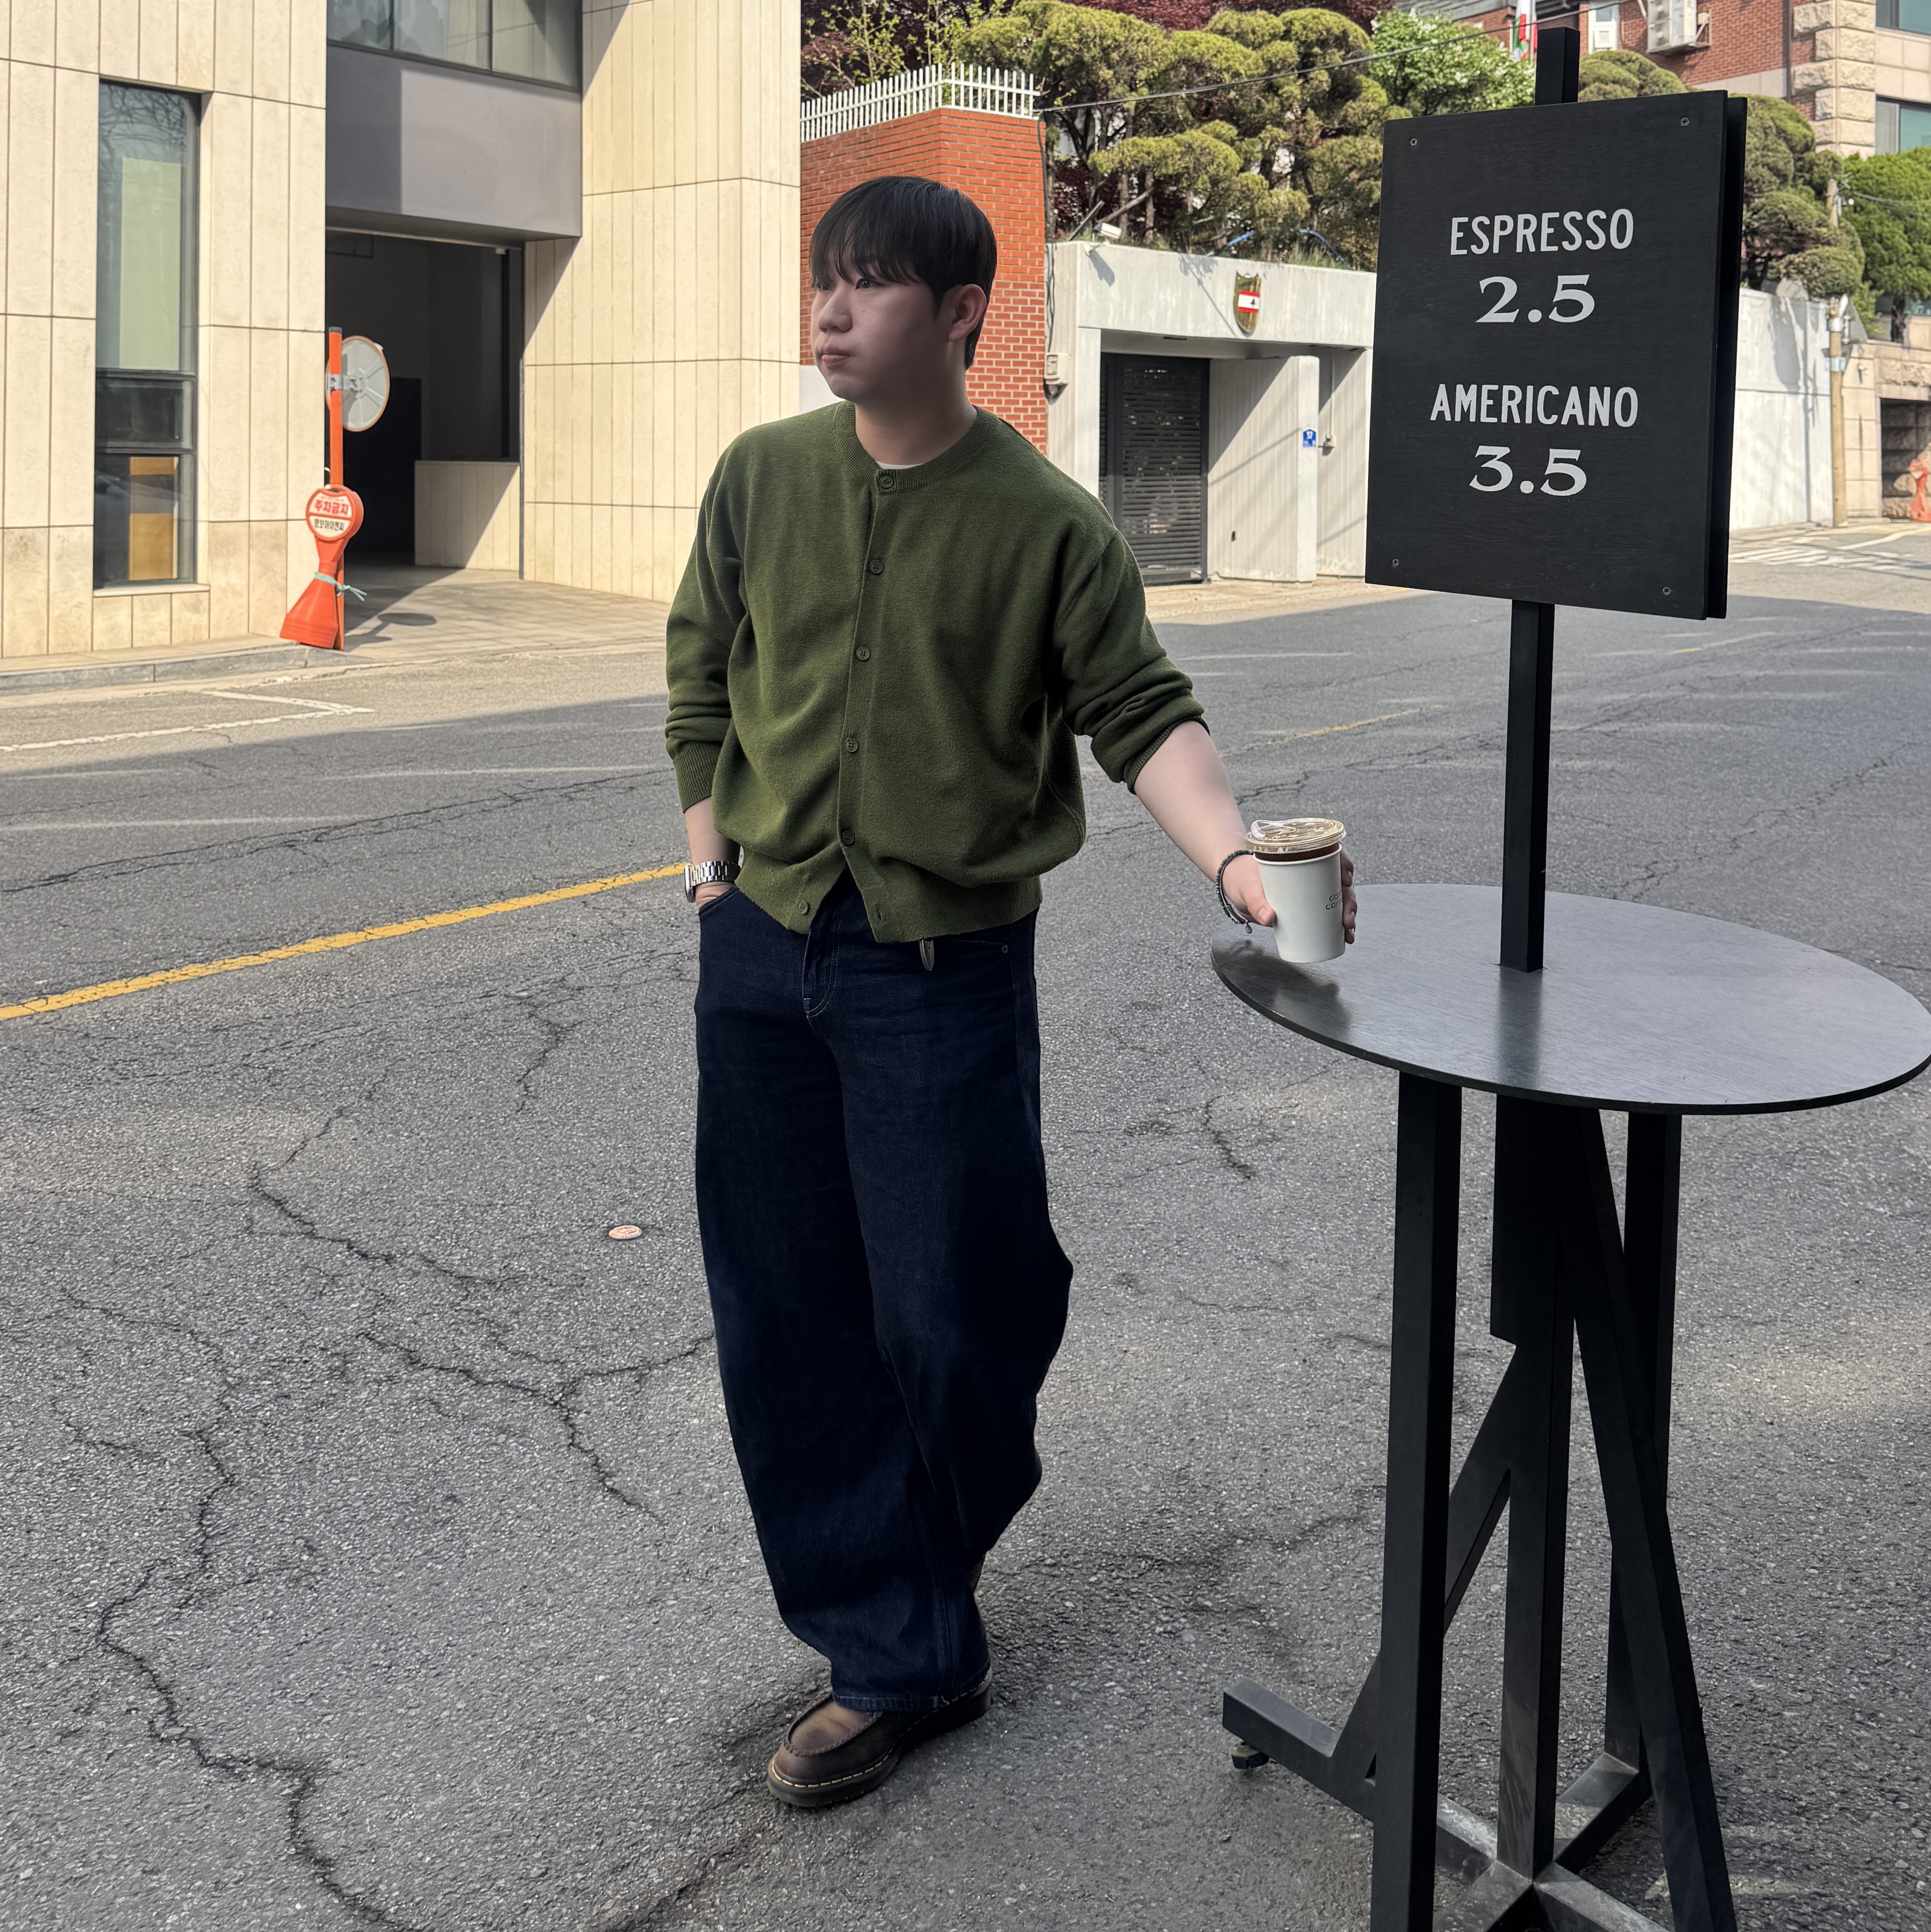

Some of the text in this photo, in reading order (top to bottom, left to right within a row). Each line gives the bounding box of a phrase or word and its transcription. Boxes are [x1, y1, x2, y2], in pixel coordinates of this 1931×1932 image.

[1450, 208, 1634, 256] ESPRESSO
[1476, 274, 1595, 323] 2.5
[1430, 383, 1638, 428] AMERICANO
[1469, 445, 1587, 496] 3.5
[315, 500, 349, 515] 주차금지
